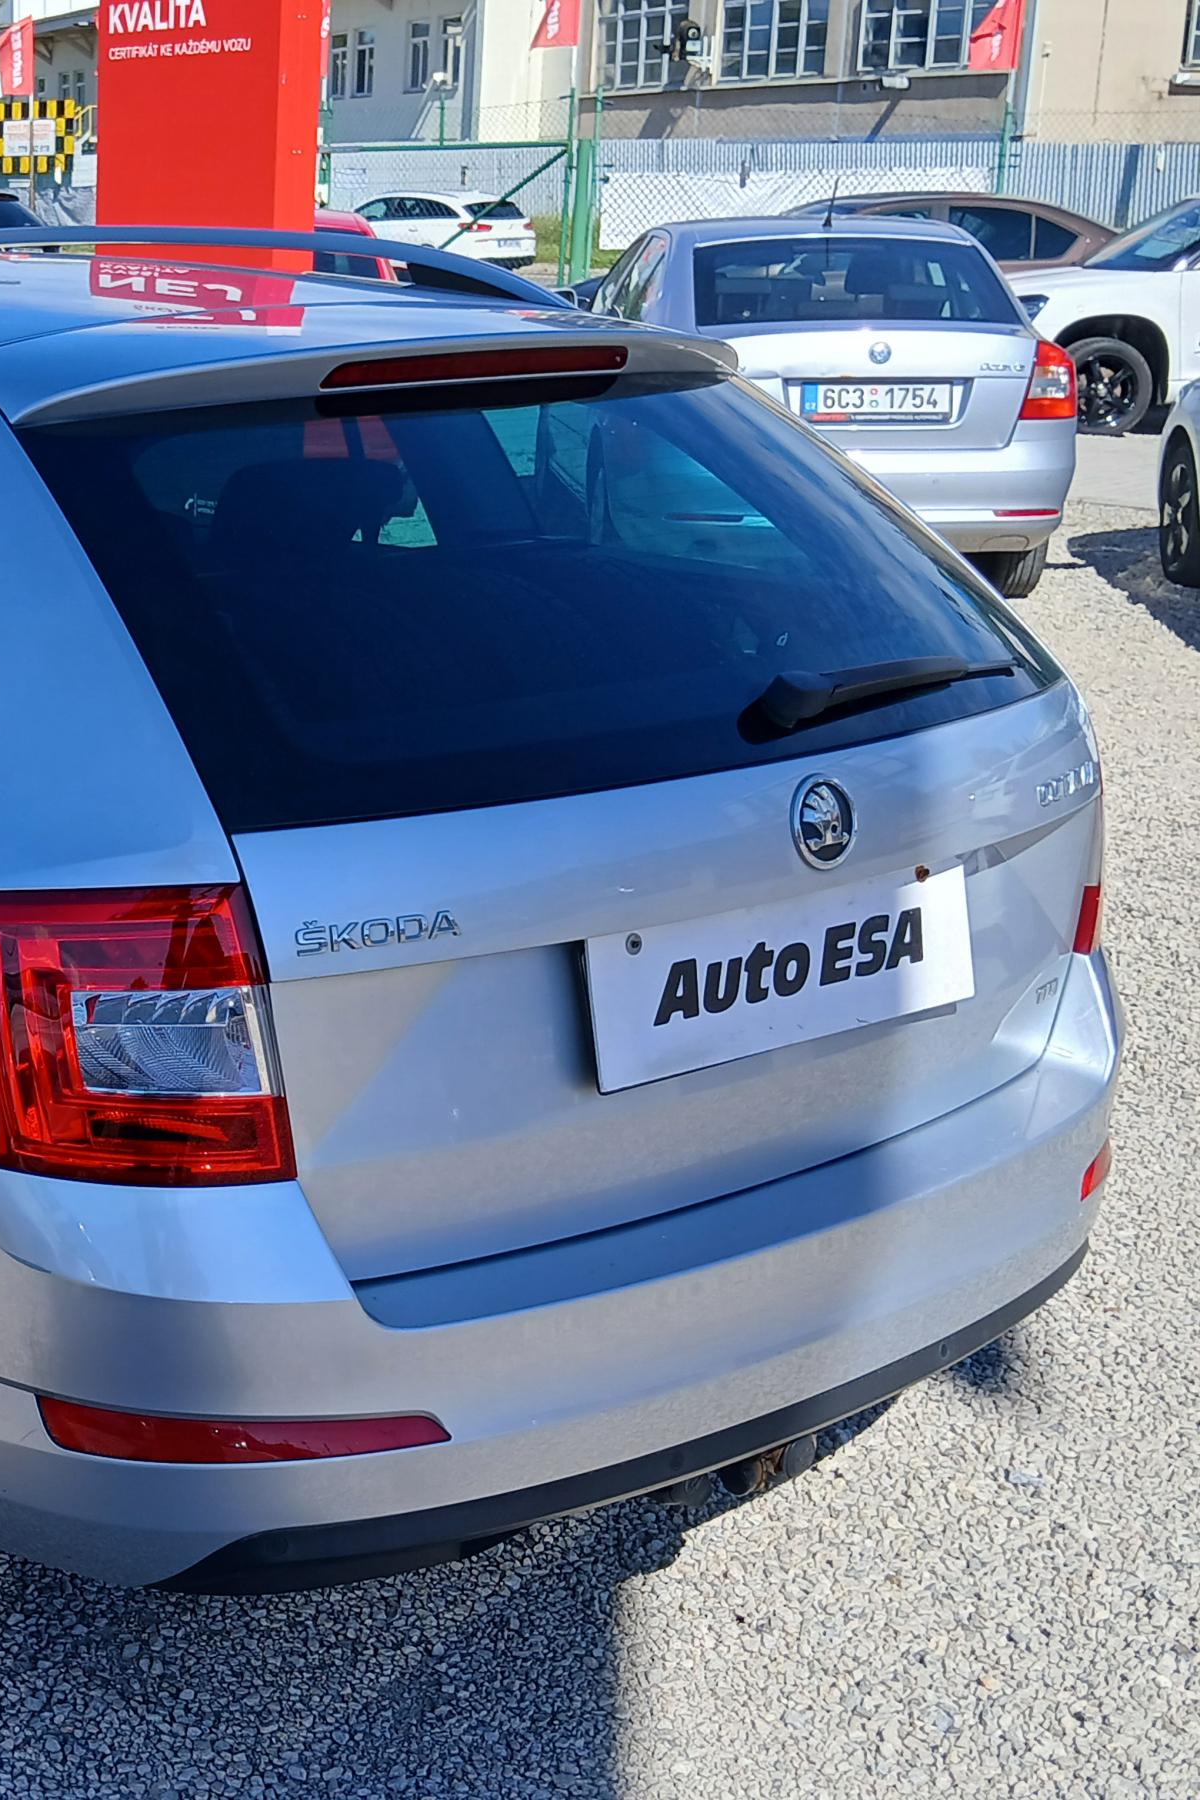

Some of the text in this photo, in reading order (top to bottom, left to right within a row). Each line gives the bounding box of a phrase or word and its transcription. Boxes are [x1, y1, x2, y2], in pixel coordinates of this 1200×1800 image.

[108, 0, 207, 34] KVALITA
[108, 37, 252, 60] CERTIFIKÁT KE KAŽDÉMU VOZU
[823, 387, 865, 409] 6C3
[885, 387, 938, 409] 1754
[294, 910, 462, 957] ŠKODA
[653, 907, 924, 1027] Auto ESA
